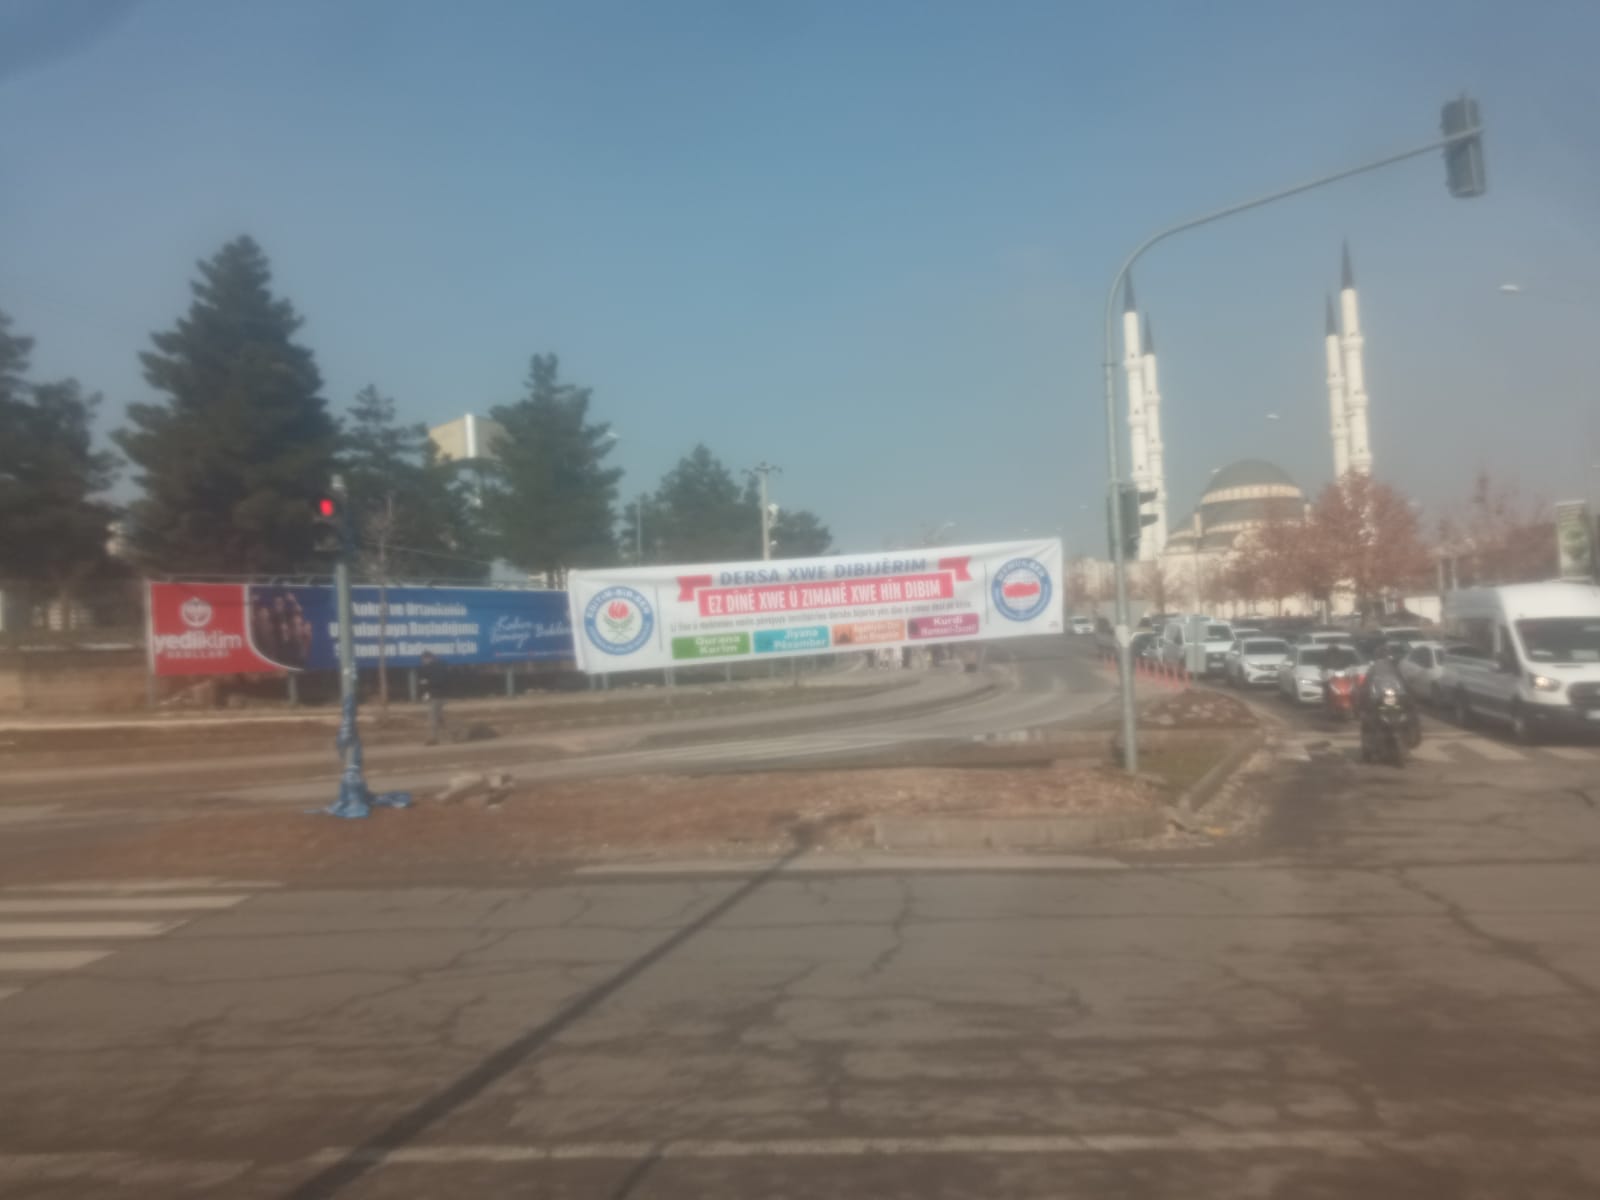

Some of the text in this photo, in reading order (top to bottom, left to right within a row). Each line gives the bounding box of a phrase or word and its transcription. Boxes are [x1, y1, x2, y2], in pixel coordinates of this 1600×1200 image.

[720, 568, 779, 586] DERSA
[788, 565, 827, 583] XWE
[708, 594, 722, 613] EZ
[759, 591, 786, 610] XWE
[850, 583, 878, 603] XWE
[905, 579, 942, 600] DIBIM
